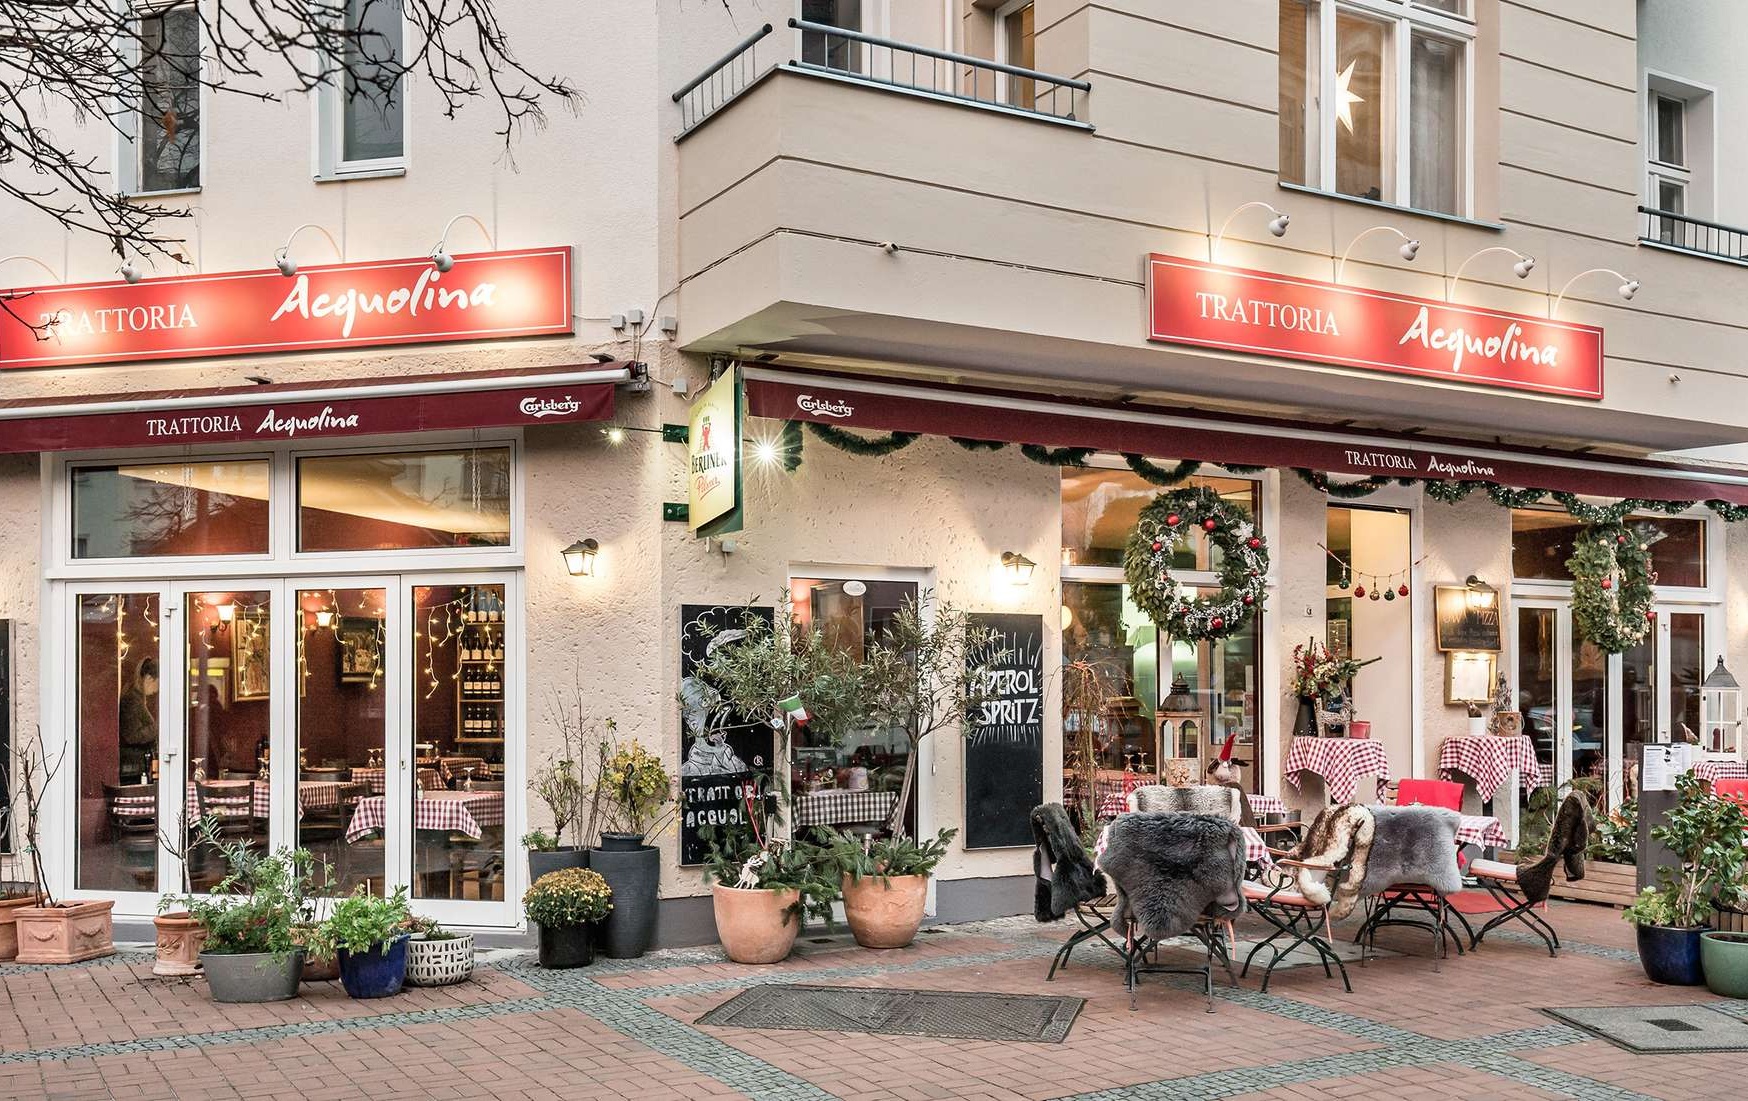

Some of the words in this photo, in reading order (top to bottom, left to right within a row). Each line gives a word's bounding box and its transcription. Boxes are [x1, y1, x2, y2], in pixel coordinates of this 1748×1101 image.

[40, 303, 198, 338] TRATTORIA
[271, 267, 498, 338] Acquolina
[1196, 291, 1340, 337] TRATTORIA
[1398, 305, 1559, 373] Acquolina
[519, 395, 582, 419] Carlsberg
[796, 394, 855, 418] Carlsberg
[146, 415, 242, 436] TRATTORIA
[255, 405, 359, 437] Acquolina
[691, 452, 728, 474] BERLINER
[1345, 450, 1417, 470] TRATTORIA
[1427, 455, 1495, 477] Acquolina
